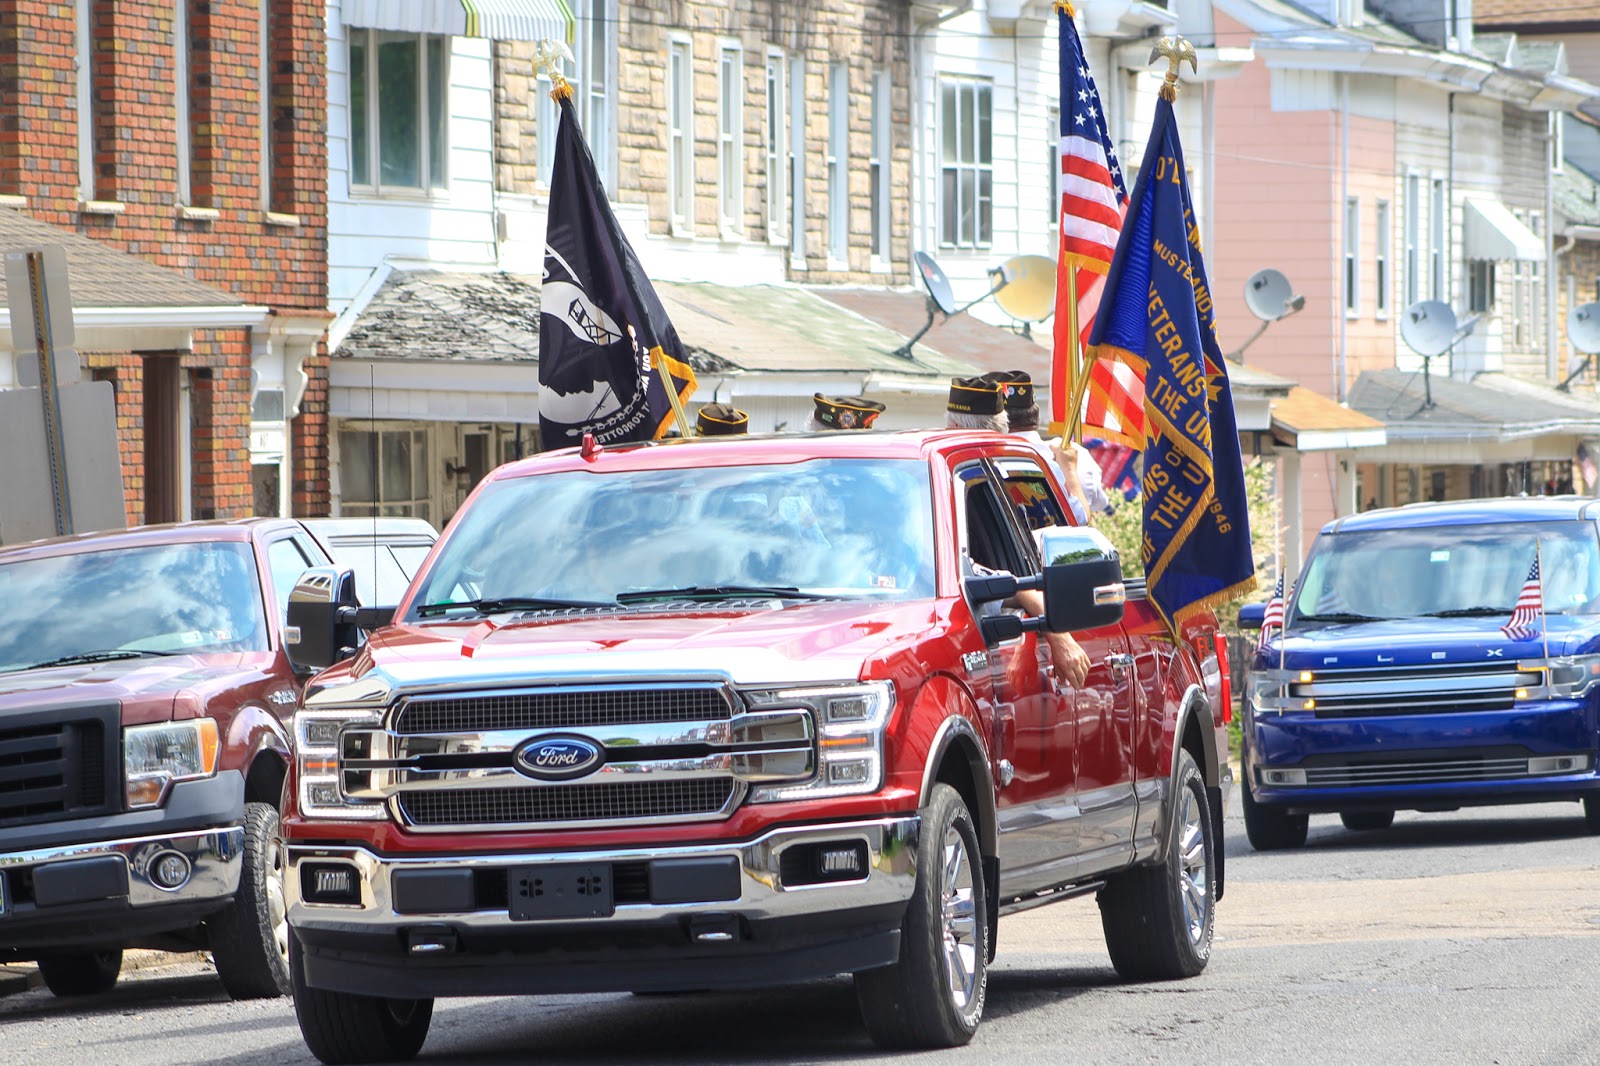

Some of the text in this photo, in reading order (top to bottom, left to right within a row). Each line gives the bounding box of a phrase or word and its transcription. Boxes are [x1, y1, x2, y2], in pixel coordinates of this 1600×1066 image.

[1148, 281, 1207, 397] VETERANS
[1151, 375, 1212, 452] THE UN
[1150, 485, 1192, 529] THE
[1182, 462, 1205, 485] U
[1209, 497, 1232, 534] 1946
[536, 746, 578, 765] Ford
